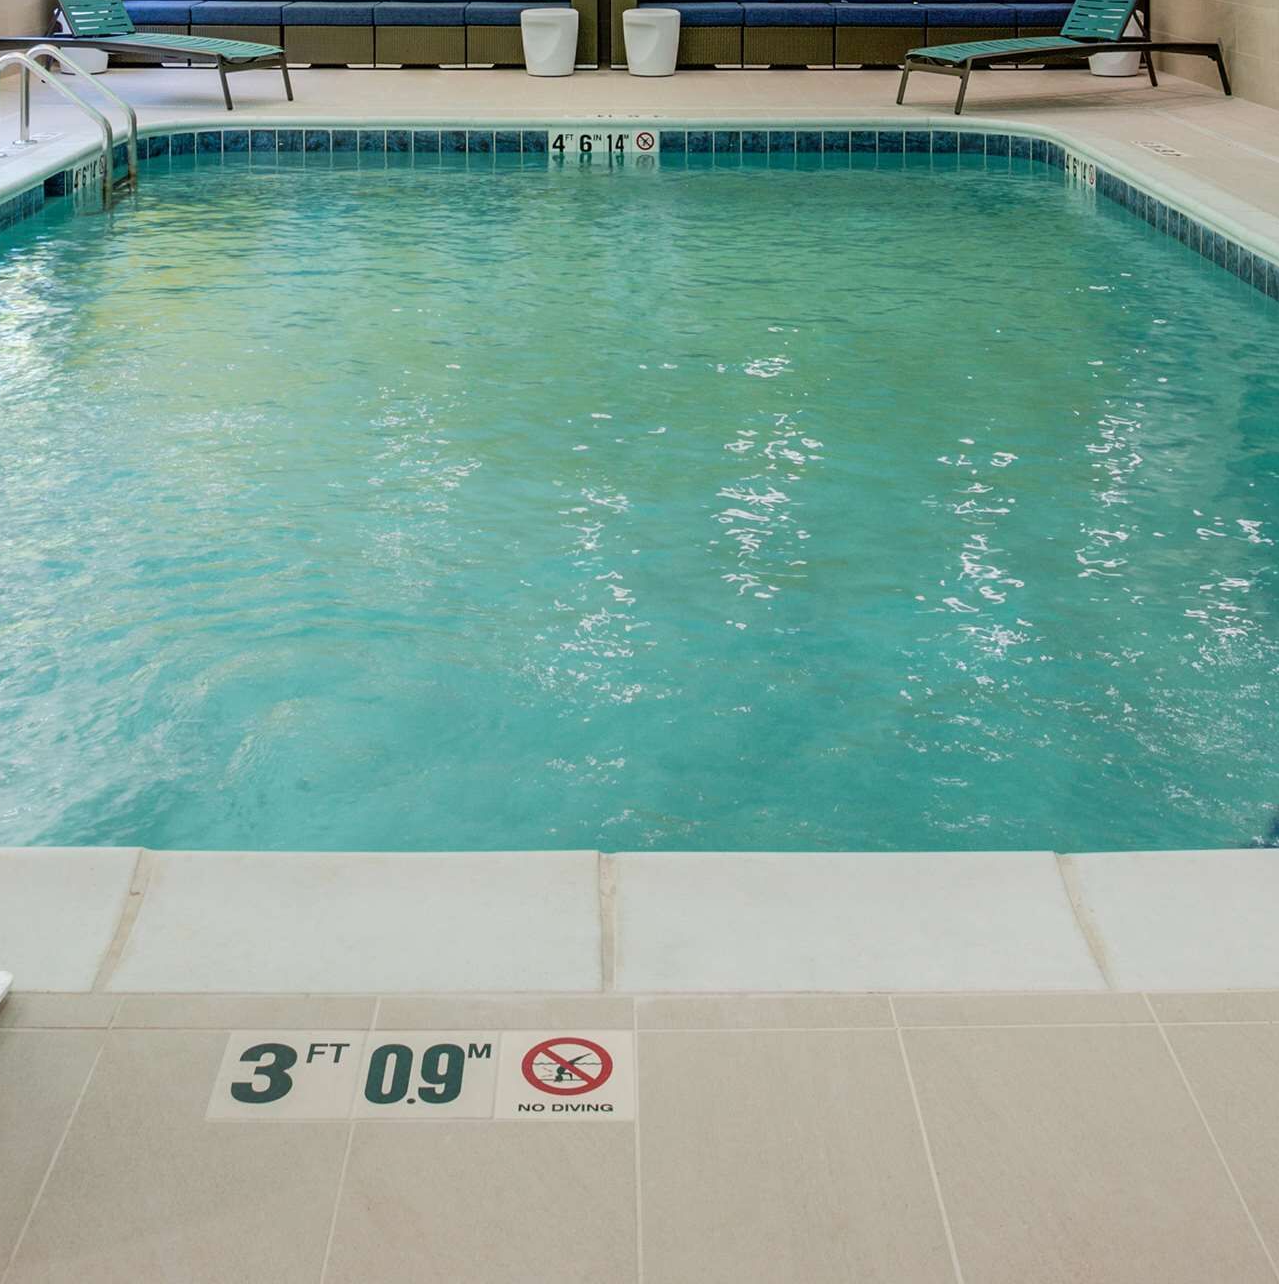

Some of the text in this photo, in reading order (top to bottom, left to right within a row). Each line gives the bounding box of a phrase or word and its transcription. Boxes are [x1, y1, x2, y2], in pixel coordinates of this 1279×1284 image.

[552, 134, 565, 152] 4
[580, 134, 592, 152] 6
[231, 1043, 492, 1104] 3 FT 0.9 M
[518, 1103, 614, 1112] NO DIVING
